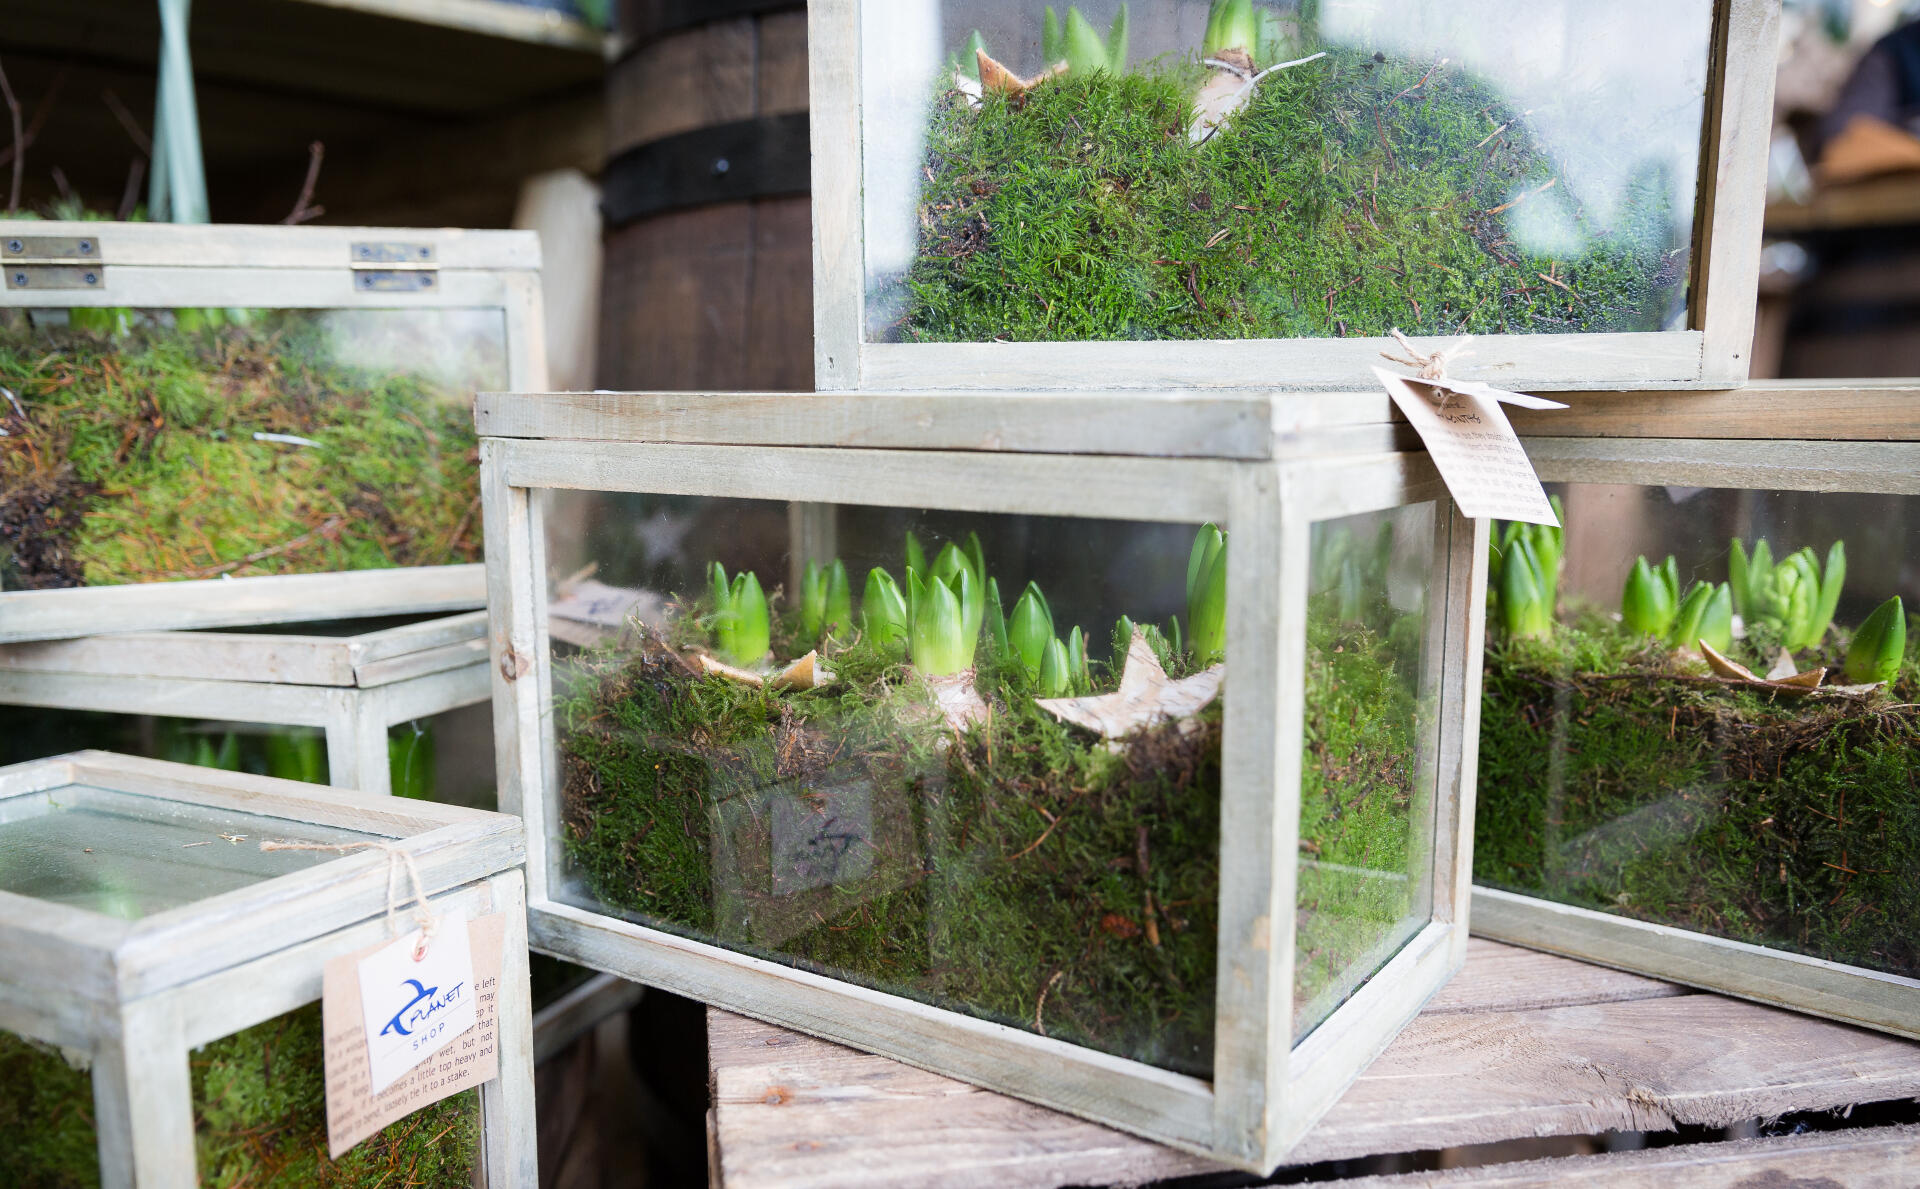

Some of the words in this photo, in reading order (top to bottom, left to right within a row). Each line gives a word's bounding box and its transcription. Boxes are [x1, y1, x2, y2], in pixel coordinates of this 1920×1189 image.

[482, 976, 496, 989] left
[411, 982, 463, 1028] PLANET
[479, 992, 495, 1003] may
[488, 1004, 494, 1013] it
[413, 1022, 445, 1051] SHOP
[478, 1018, 494, 1030] that
[439, 1046, 456, 1057] wet,
[462, 1037, 476, 1050] but
[481, 1031, 493, 1043] not
[377, 1079, 408, 1101] becomes
[410, 1076, 415, 1085] a
[417, 1067, 436, 1081] little
[439, 1061, 452, 1073] top
[455, 1052, 477, 1067] heavy
[479, 1043, 493, 1056] and
[410, 1088, 420, 1100] tie
[422, 1083, 428, 1093] it
[430, 1079, 439, 1090] to
[440, 1077, 445, 1086] a
[447, 1069, 470, 1084] stake.
